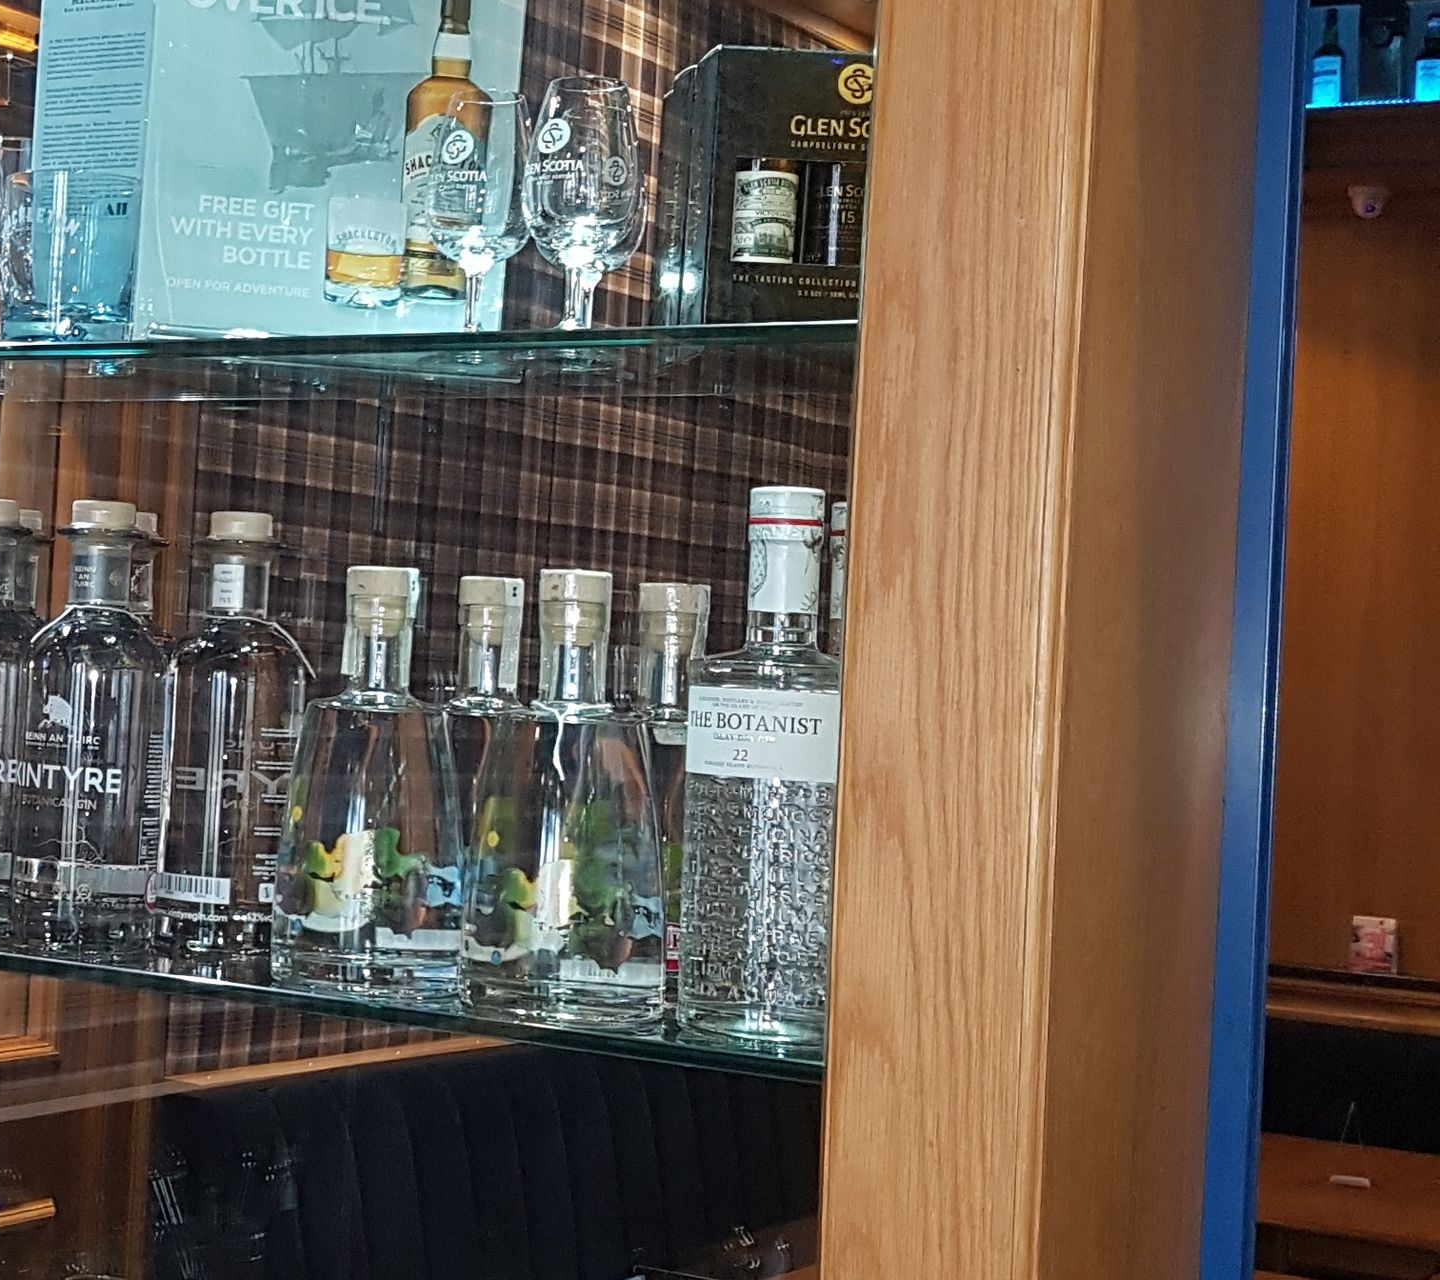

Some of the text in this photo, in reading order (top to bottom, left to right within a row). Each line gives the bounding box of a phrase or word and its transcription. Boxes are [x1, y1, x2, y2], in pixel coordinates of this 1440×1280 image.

[790, 115, 845, 137] GLEN
[542, 159, 585, 173] SCOTIA
[446, 170, 488, 183] SCOTIA
[198, 194, 315, 222] FREE GIFT
[841, 210, 856, 224] 15
[171, 216, 314, 246] WITH EVERY
[166, 277, 310, 299] OPEN FOR ADVENTURE
[732, 273, 858, 288] THE TASTING COLLECTION
[691, 710, 822, 735] THE BOTANIST
[49, 734, 64, 743] AN
[67, 735, 102, 747] TIRC
[732, 748, 748, 761] 22
[77, 795, 98, 810] GIN
